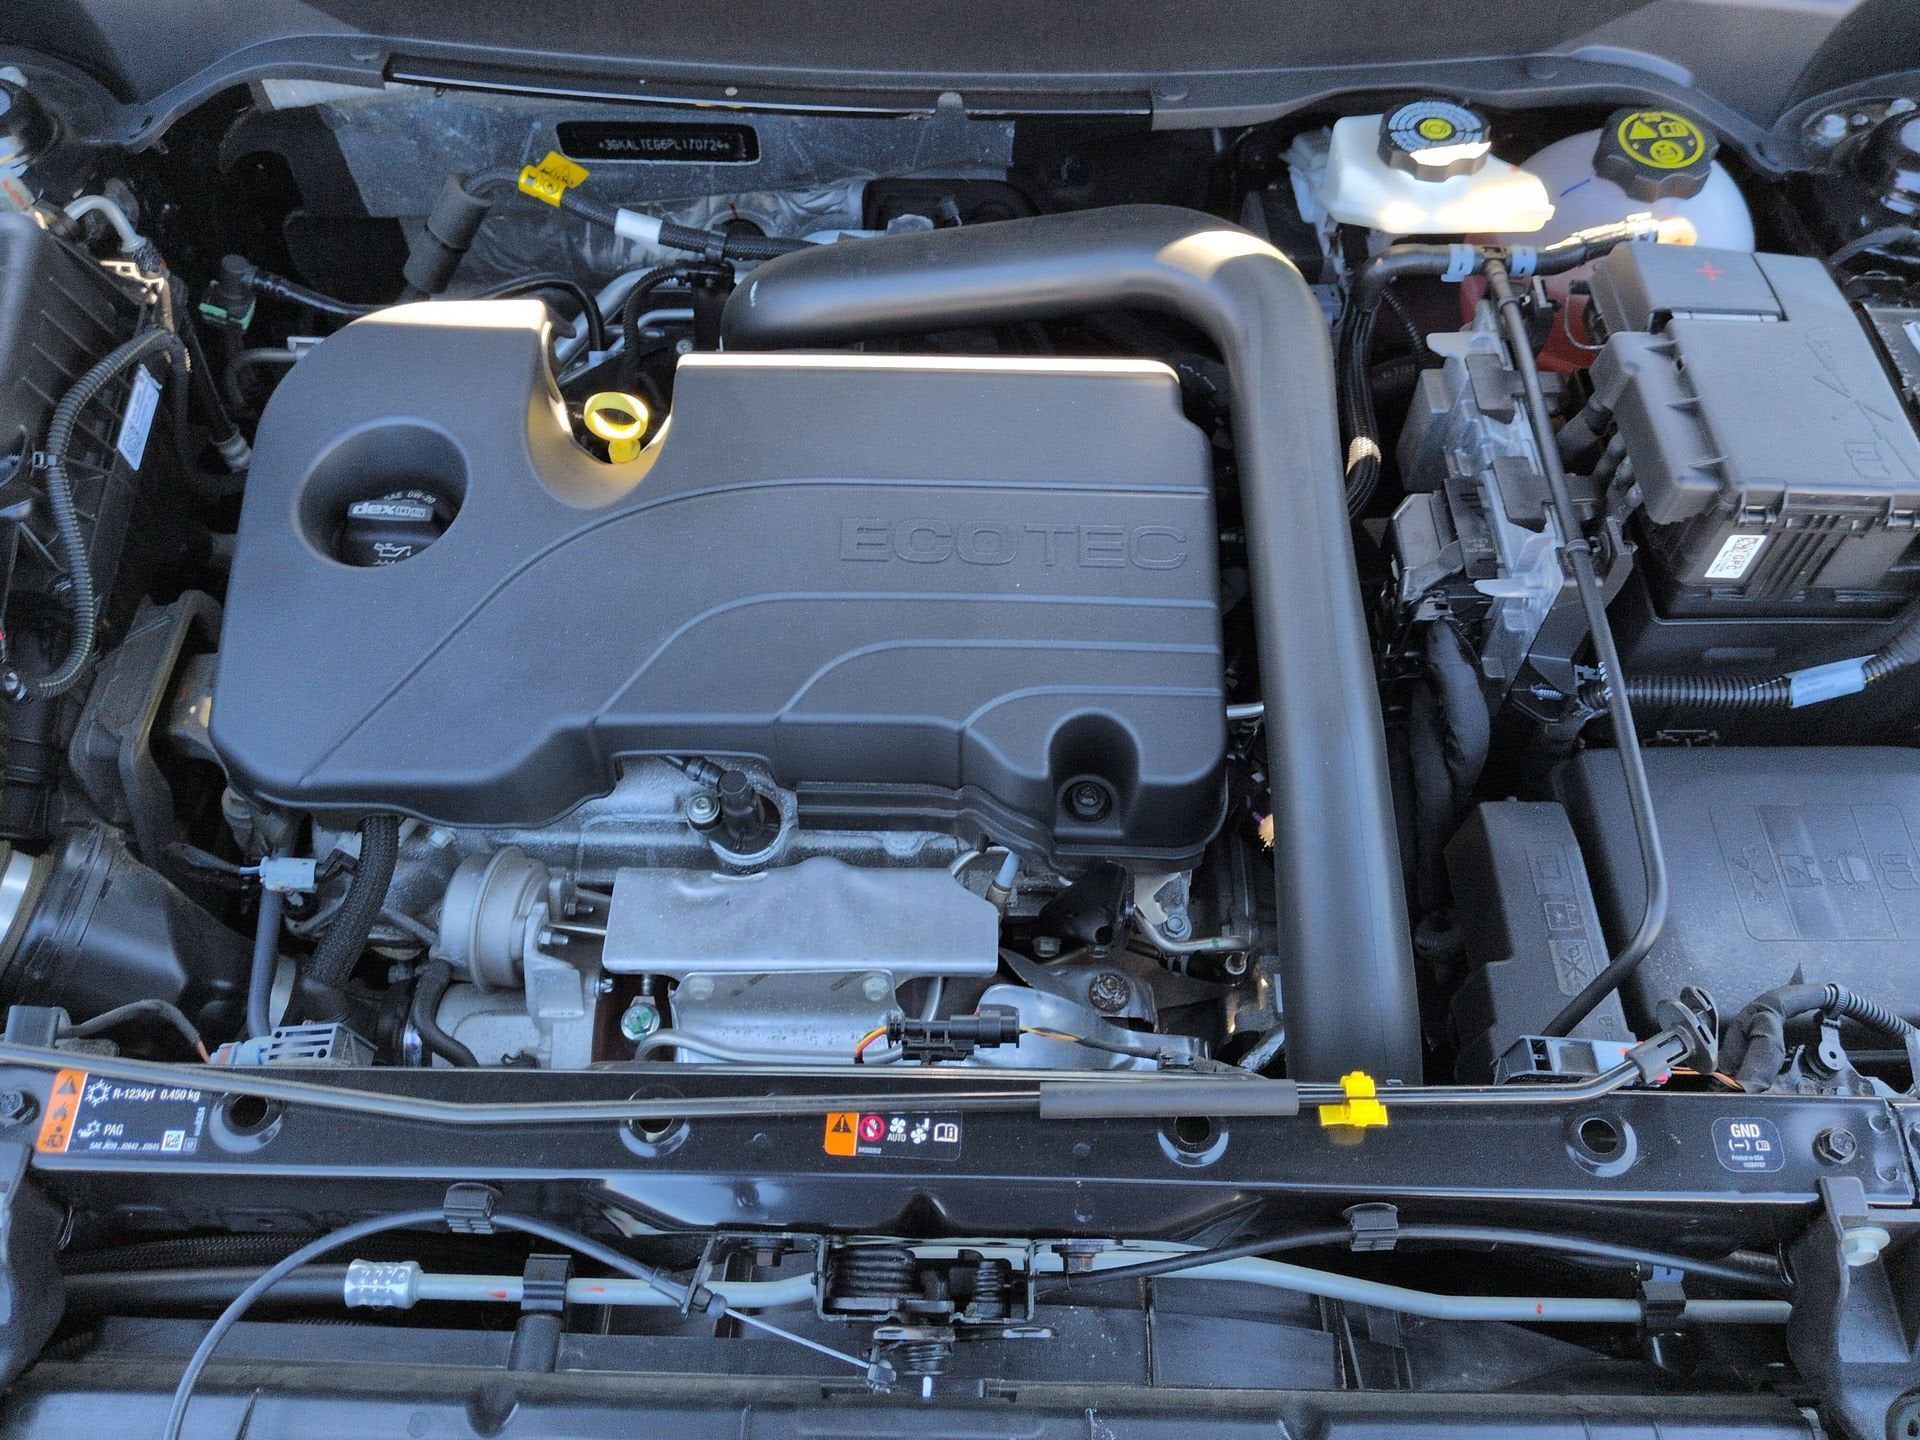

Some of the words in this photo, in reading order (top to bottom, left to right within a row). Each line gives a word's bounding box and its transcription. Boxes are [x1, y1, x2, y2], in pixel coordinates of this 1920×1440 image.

[351, 502, 427, 518] dexos
[839, 518, 1188, 570] ECOTEC
[112, 1087, 155, 1102] R-1234yf
[159, 1088, 186, 1101] 0.450
[186, 1089, 201, 1103] kg
[103, 1123, 125, 1136] PAG
[1730, 1123, 1761, 1138] GND
[887, 1133, 907, 1142] AUTO
